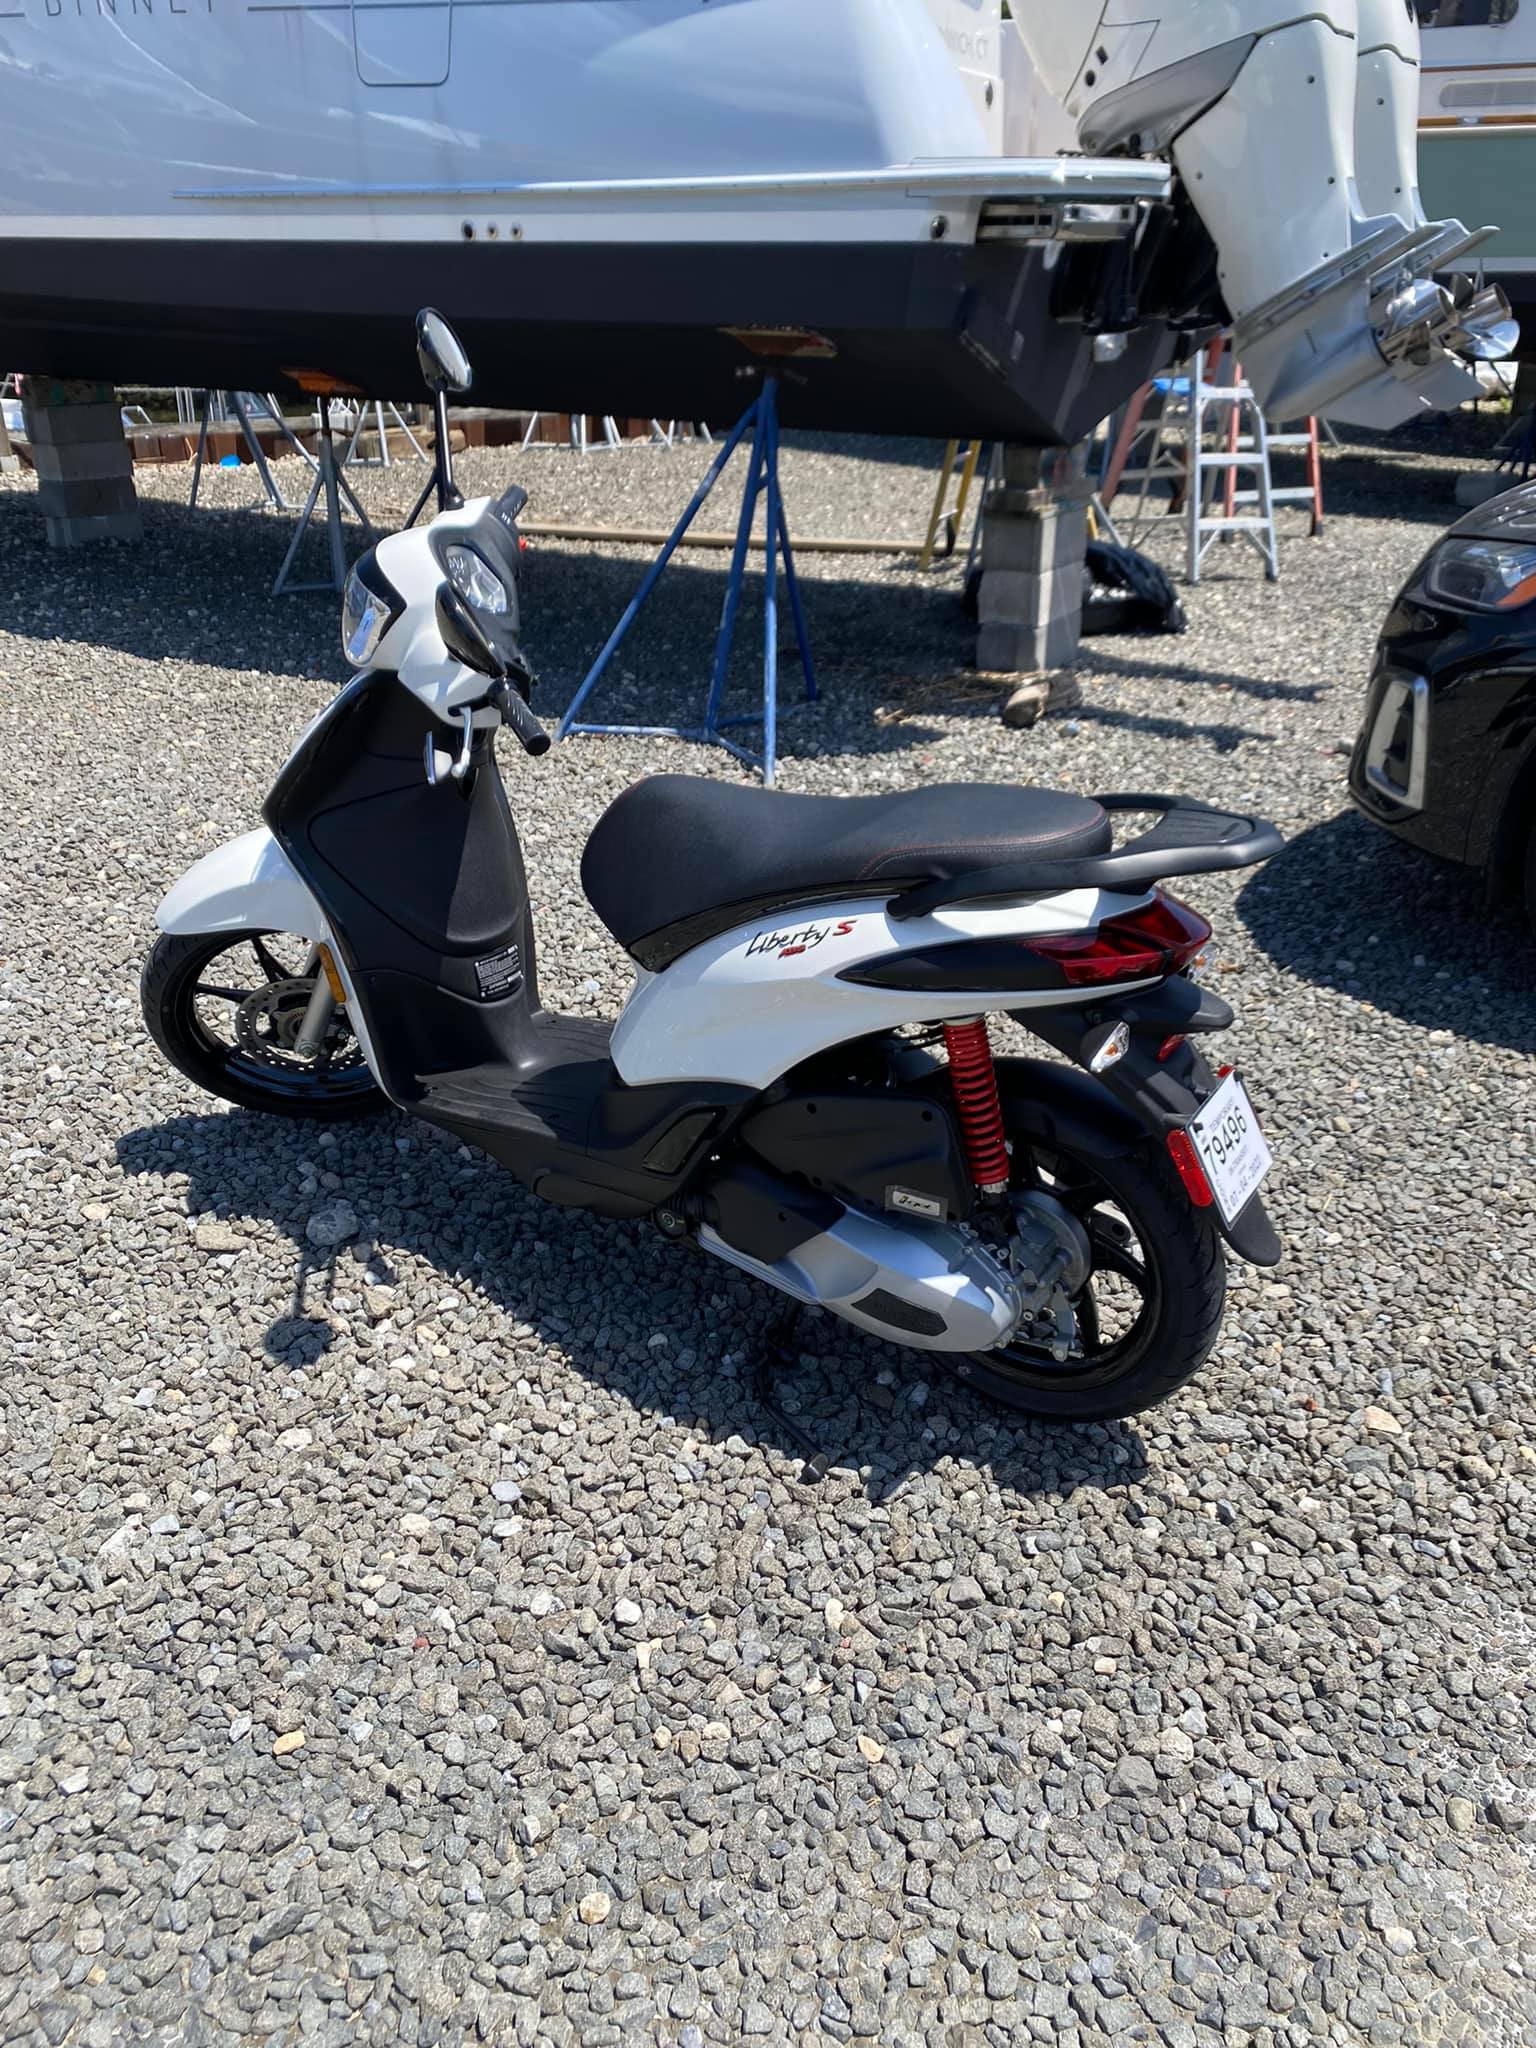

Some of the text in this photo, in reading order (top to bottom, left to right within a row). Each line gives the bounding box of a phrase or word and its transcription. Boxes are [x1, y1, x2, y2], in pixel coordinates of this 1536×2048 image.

[745, 925, 830, 958] Liberty
[833, 920, 858, 936] S
[1203, 1106, 1247, 1175] 79496
